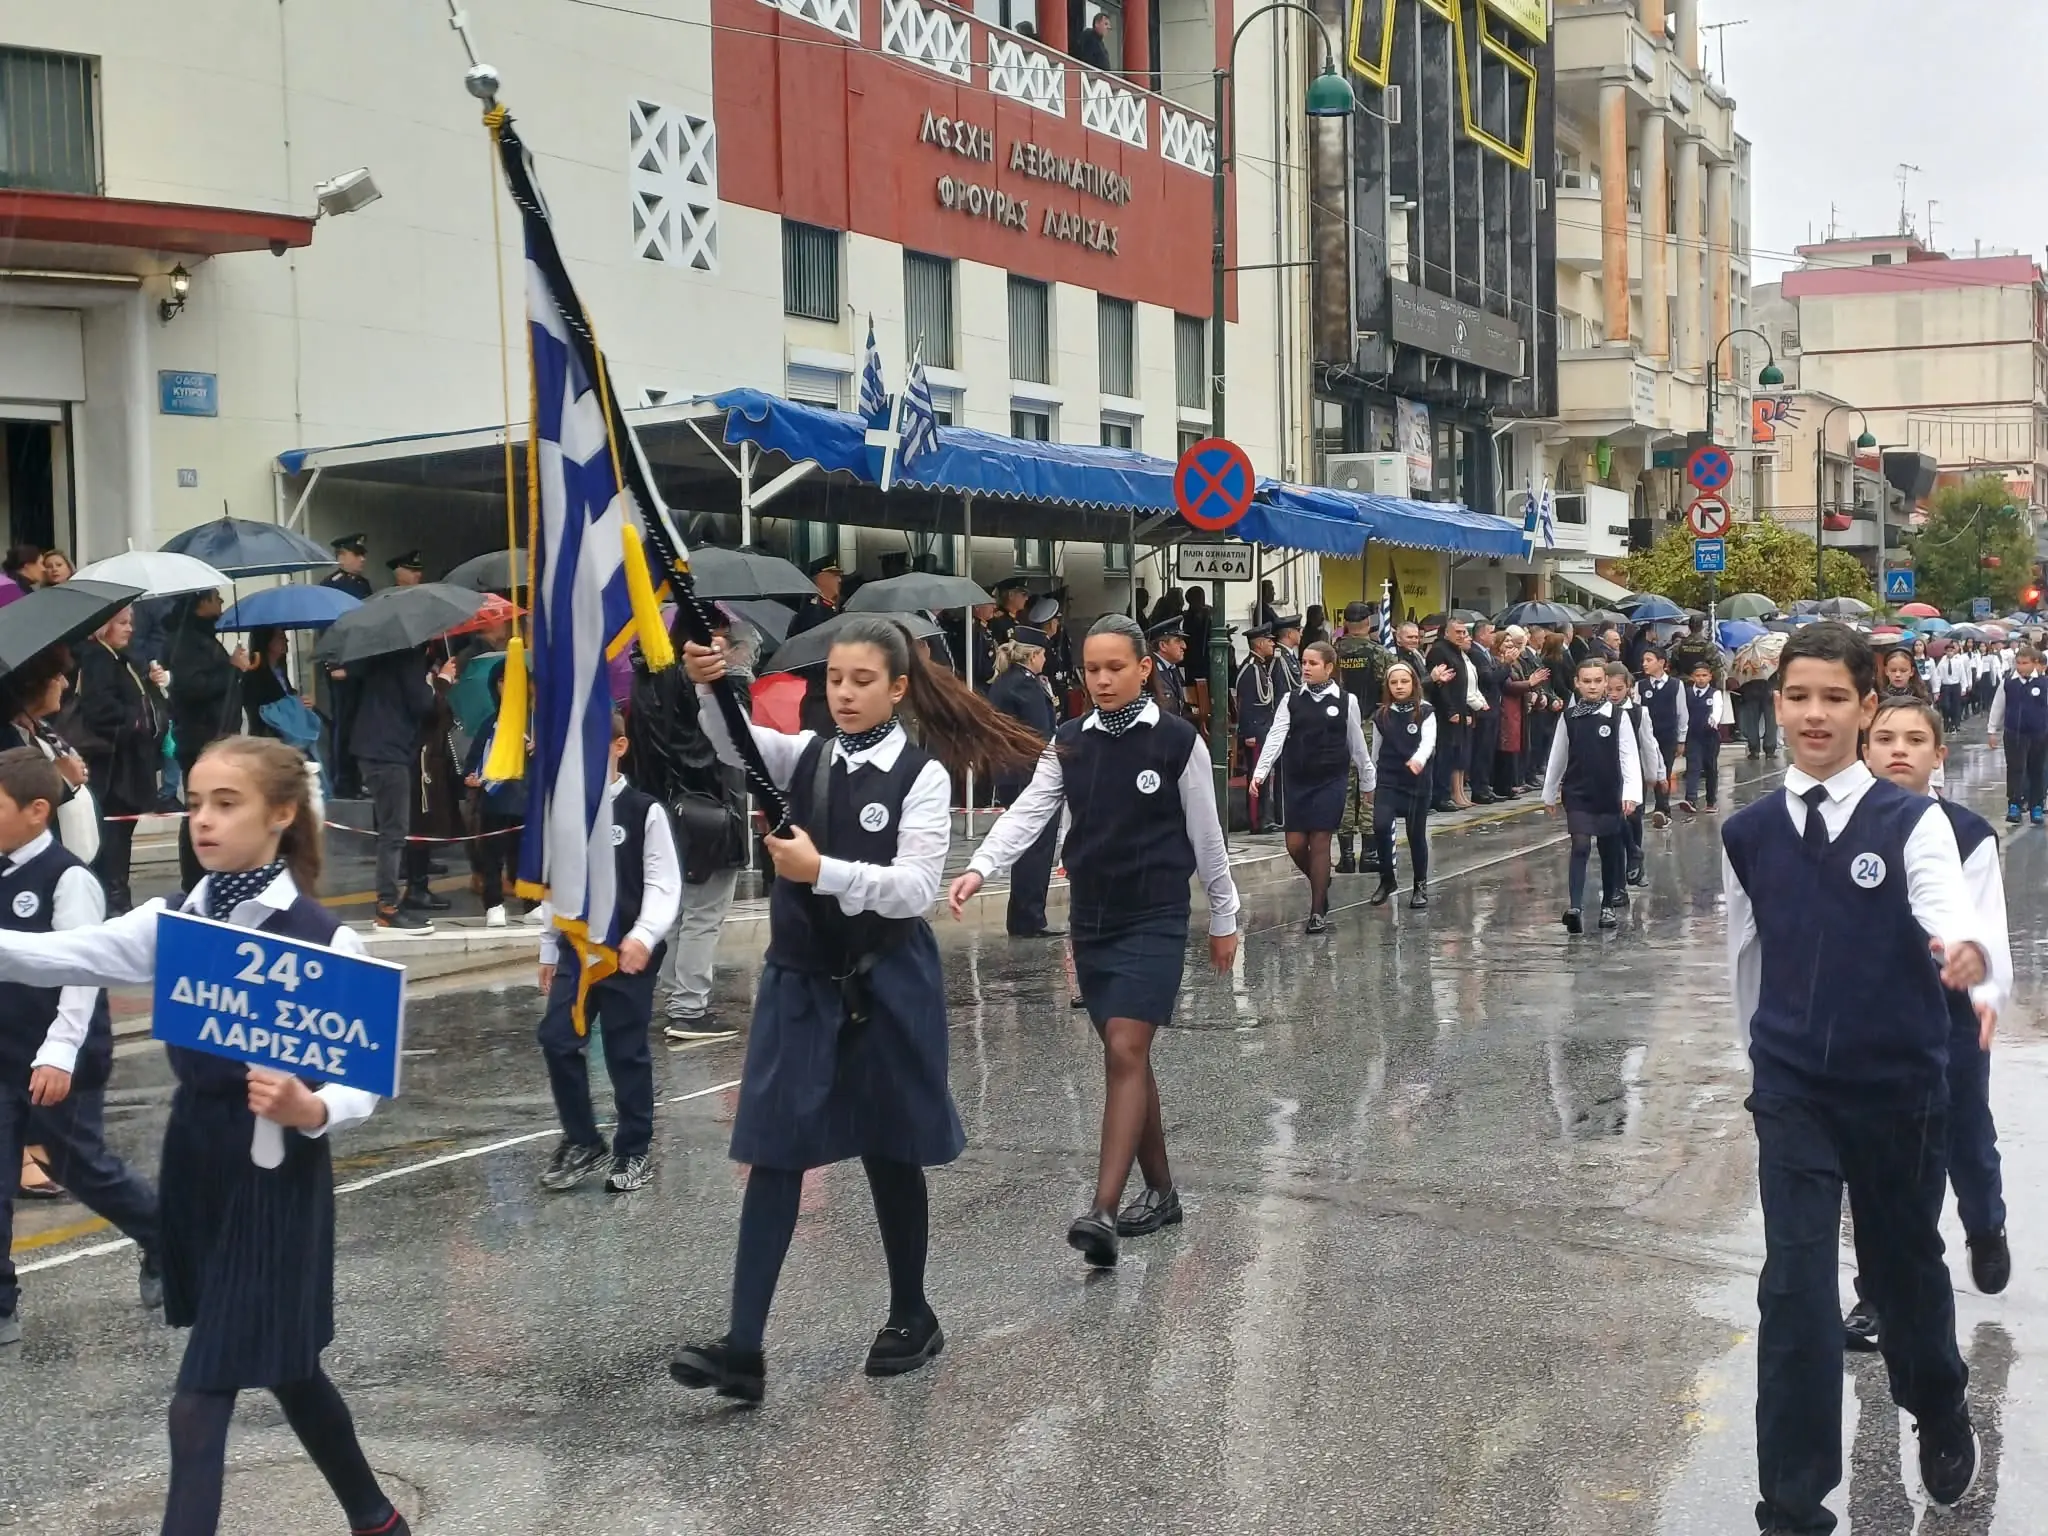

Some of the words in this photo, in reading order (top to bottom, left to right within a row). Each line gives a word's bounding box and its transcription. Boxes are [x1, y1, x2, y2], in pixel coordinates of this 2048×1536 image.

[919, 107, 993, 162] ΛΕΣΧΗ
[1008, 138, 1132, 207] ΑΞΙΩΜΑΤΙΚΩΝ
[936, 174, 1029, 232] ΦΡΟΥΡΑΣ
[1041, 207, 1120, 256] ΛΑΡΙΣΑΣ
[173, 387, 208, 398] ΚΥΠΡΟΥ
[1205, 550, 1247, 559] ΟΧΗΜΑΤΩΝ
[1140, 773, 1156, 790] 24
[864, 806, 884, 827] 24
[1857, 858, 1879, 882] 24
[169, 975, 259, 1020] ΔΗΜ.
[273, 999, 380, 1051] ΣΧΟΛ.
[197, 1016, 348, 1077] ΛΑΡΙΣΑΣ
